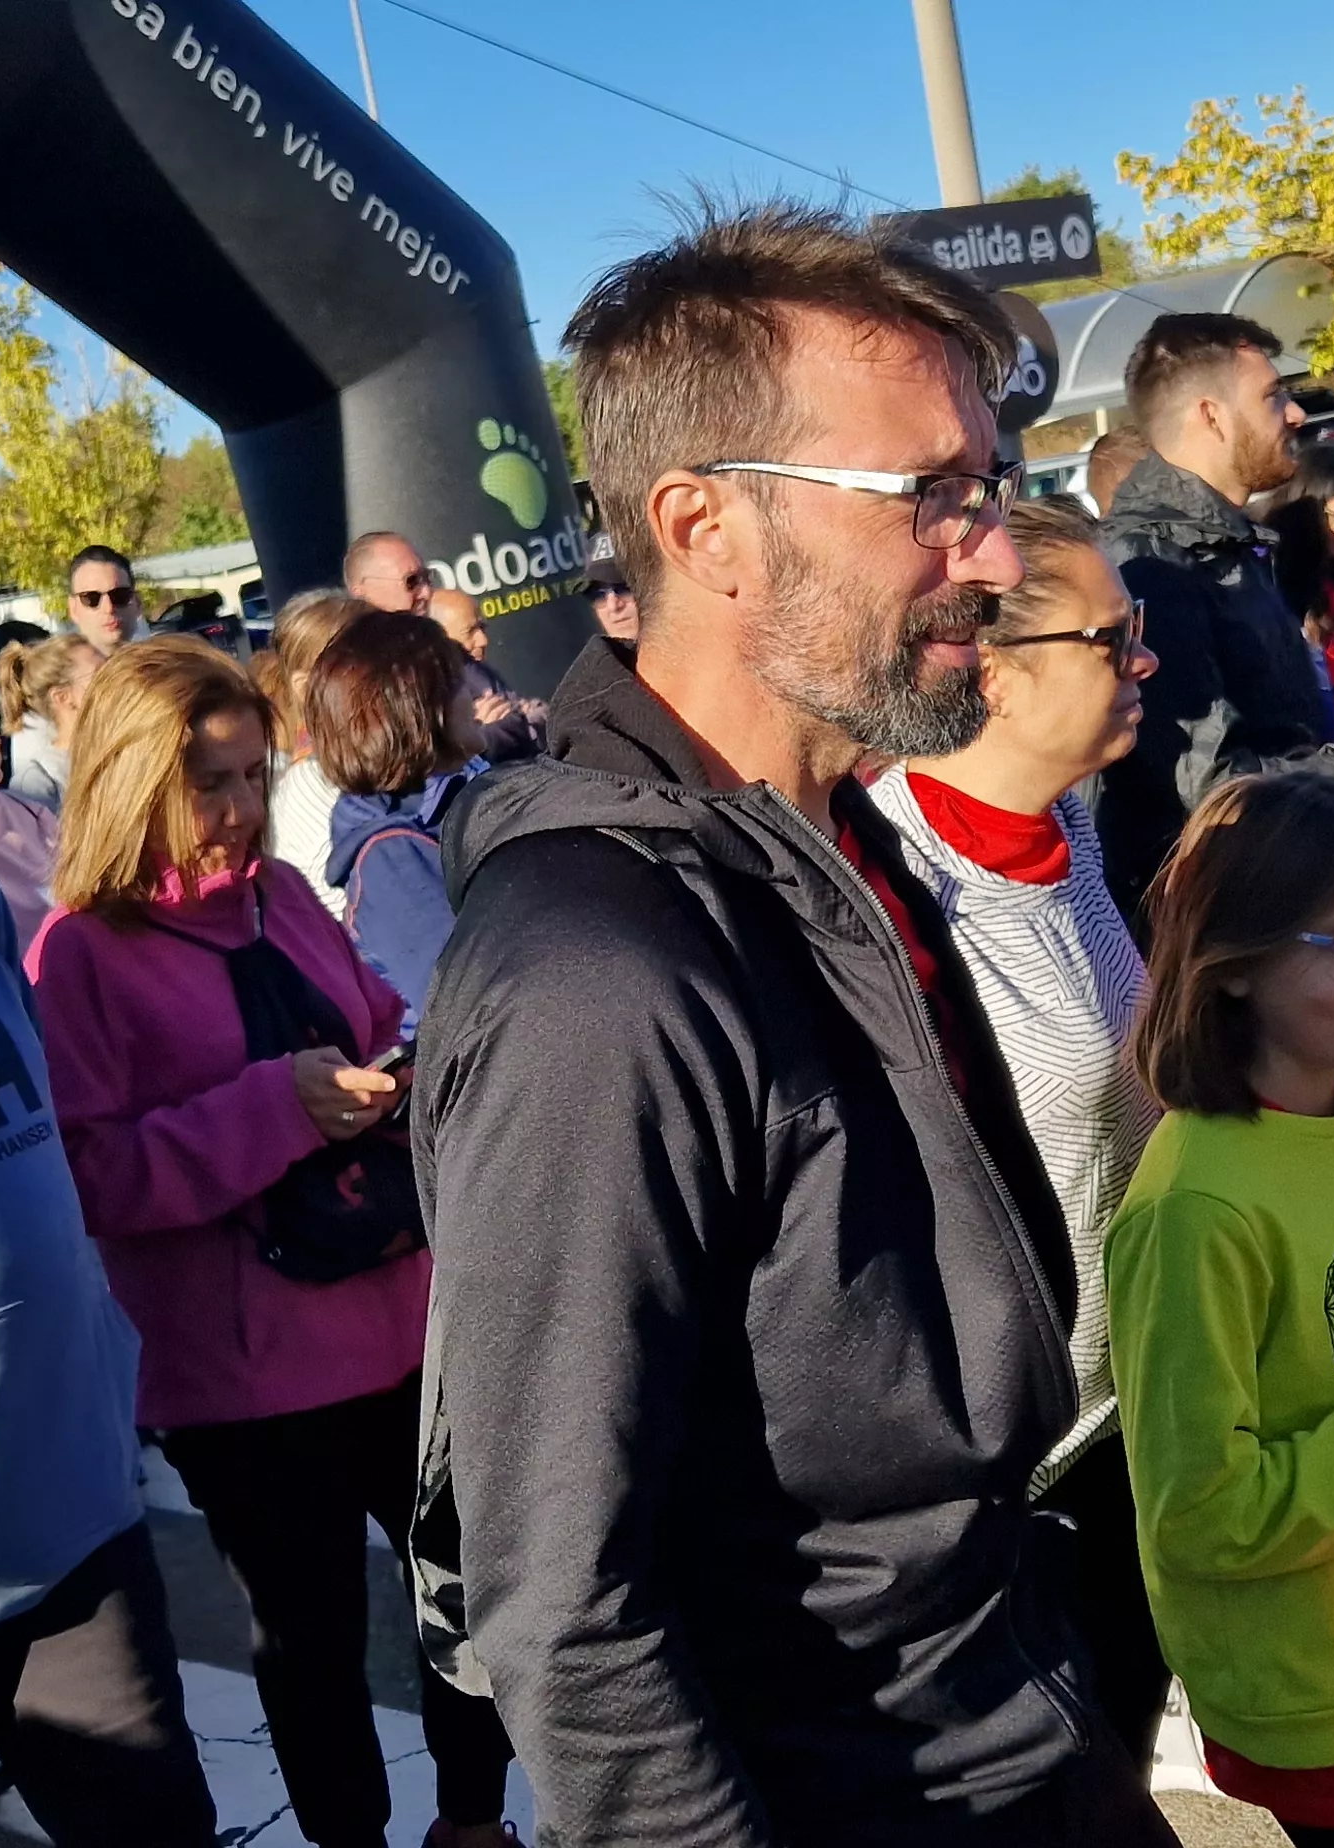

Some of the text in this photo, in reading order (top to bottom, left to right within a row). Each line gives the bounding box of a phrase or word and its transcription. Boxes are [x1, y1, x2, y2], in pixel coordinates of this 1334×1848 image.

[110, 0, 470, 295] sa bien, vive mejor
[932, 221, 1025, 272] salida
[481, 583, 551, 619] OLOGÍA
